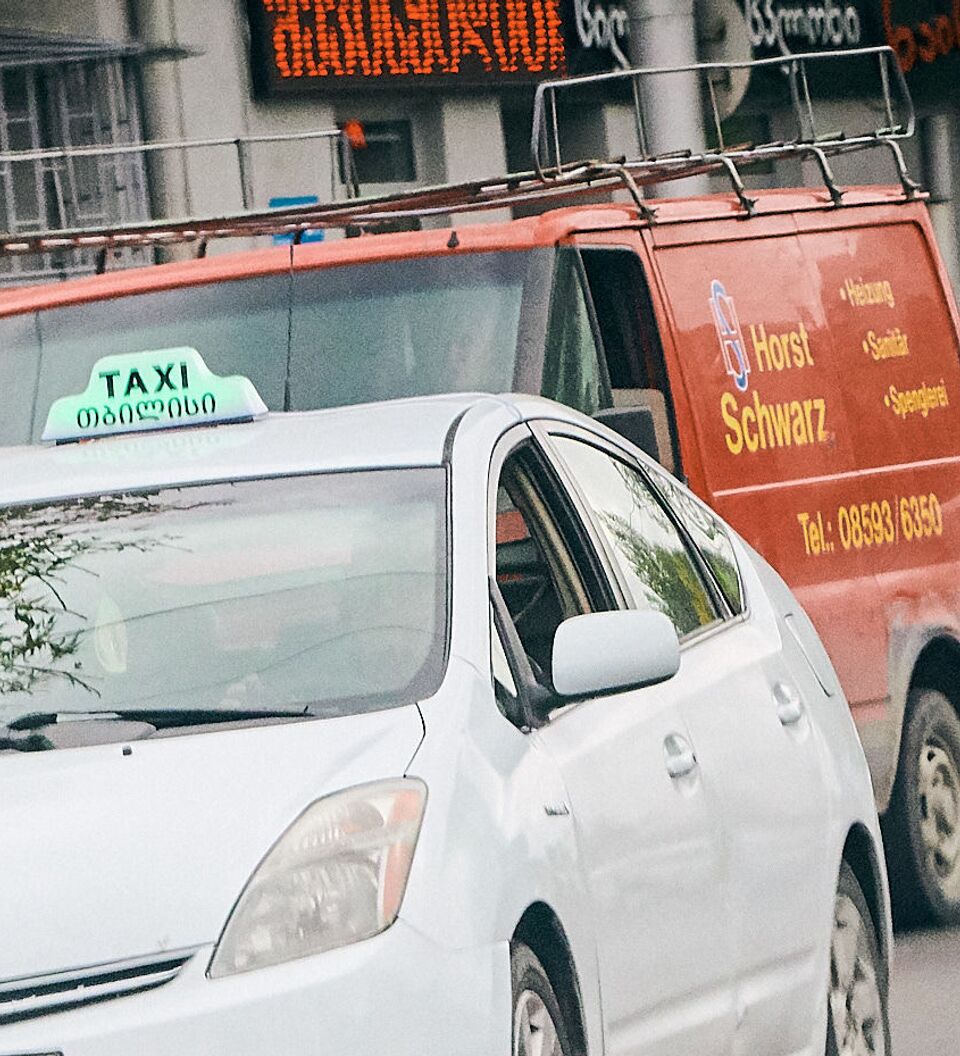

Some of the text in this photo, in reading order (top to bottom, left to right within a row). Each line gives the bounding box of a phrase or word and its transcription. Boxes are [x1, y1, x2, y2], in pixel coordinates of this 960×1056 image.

[844, 276, 895, 308] Heizung
[750, 322, 814, 372] Horst
[99, 361, 190, 398] TAXI
[889, 378, 949, 419] Spenglerei
[77, 392, 216, 429] თბილისი
[720, 390, 827, 454] Schwarz
